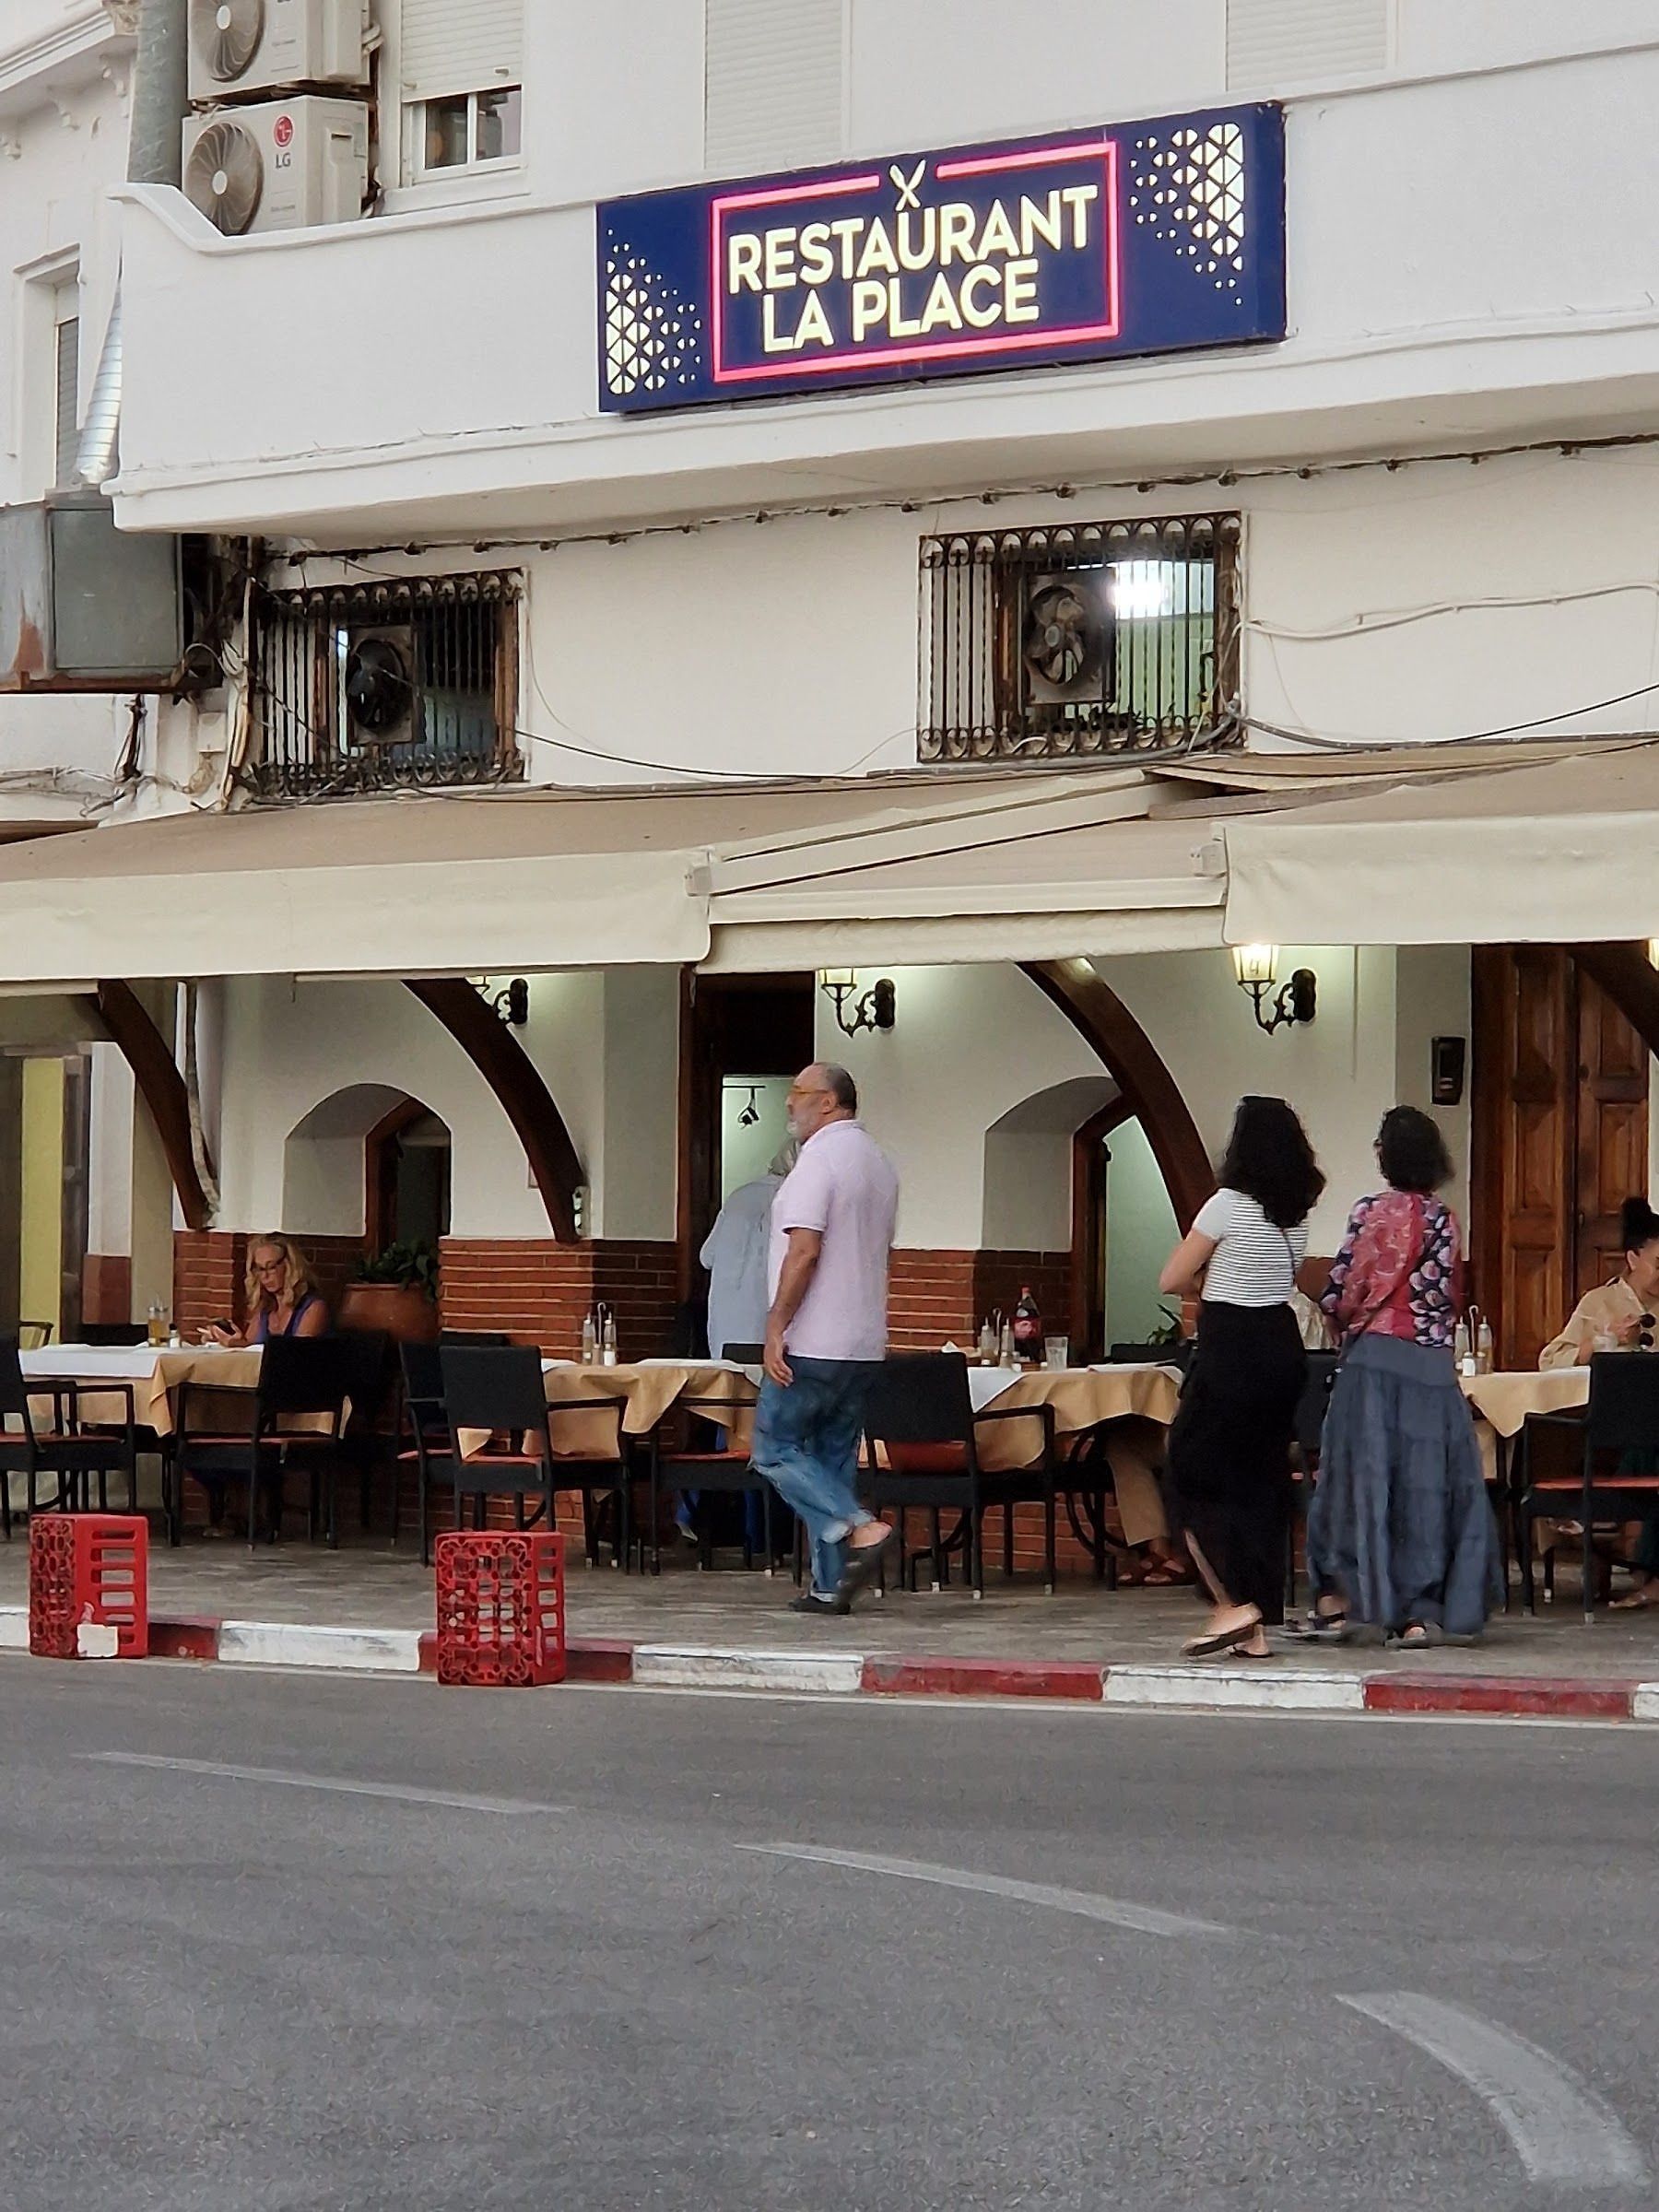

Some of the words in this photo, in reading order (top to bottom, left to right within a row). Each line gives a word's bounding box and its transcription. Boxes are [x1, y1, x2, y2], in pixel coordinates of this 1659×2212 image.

[276, 152, 291, 169] LG
[729, 184, 1099, 294] RESTAURANT
[763, 288, 834, 353] LA
[852, 258, 1040, 342] PLACE
